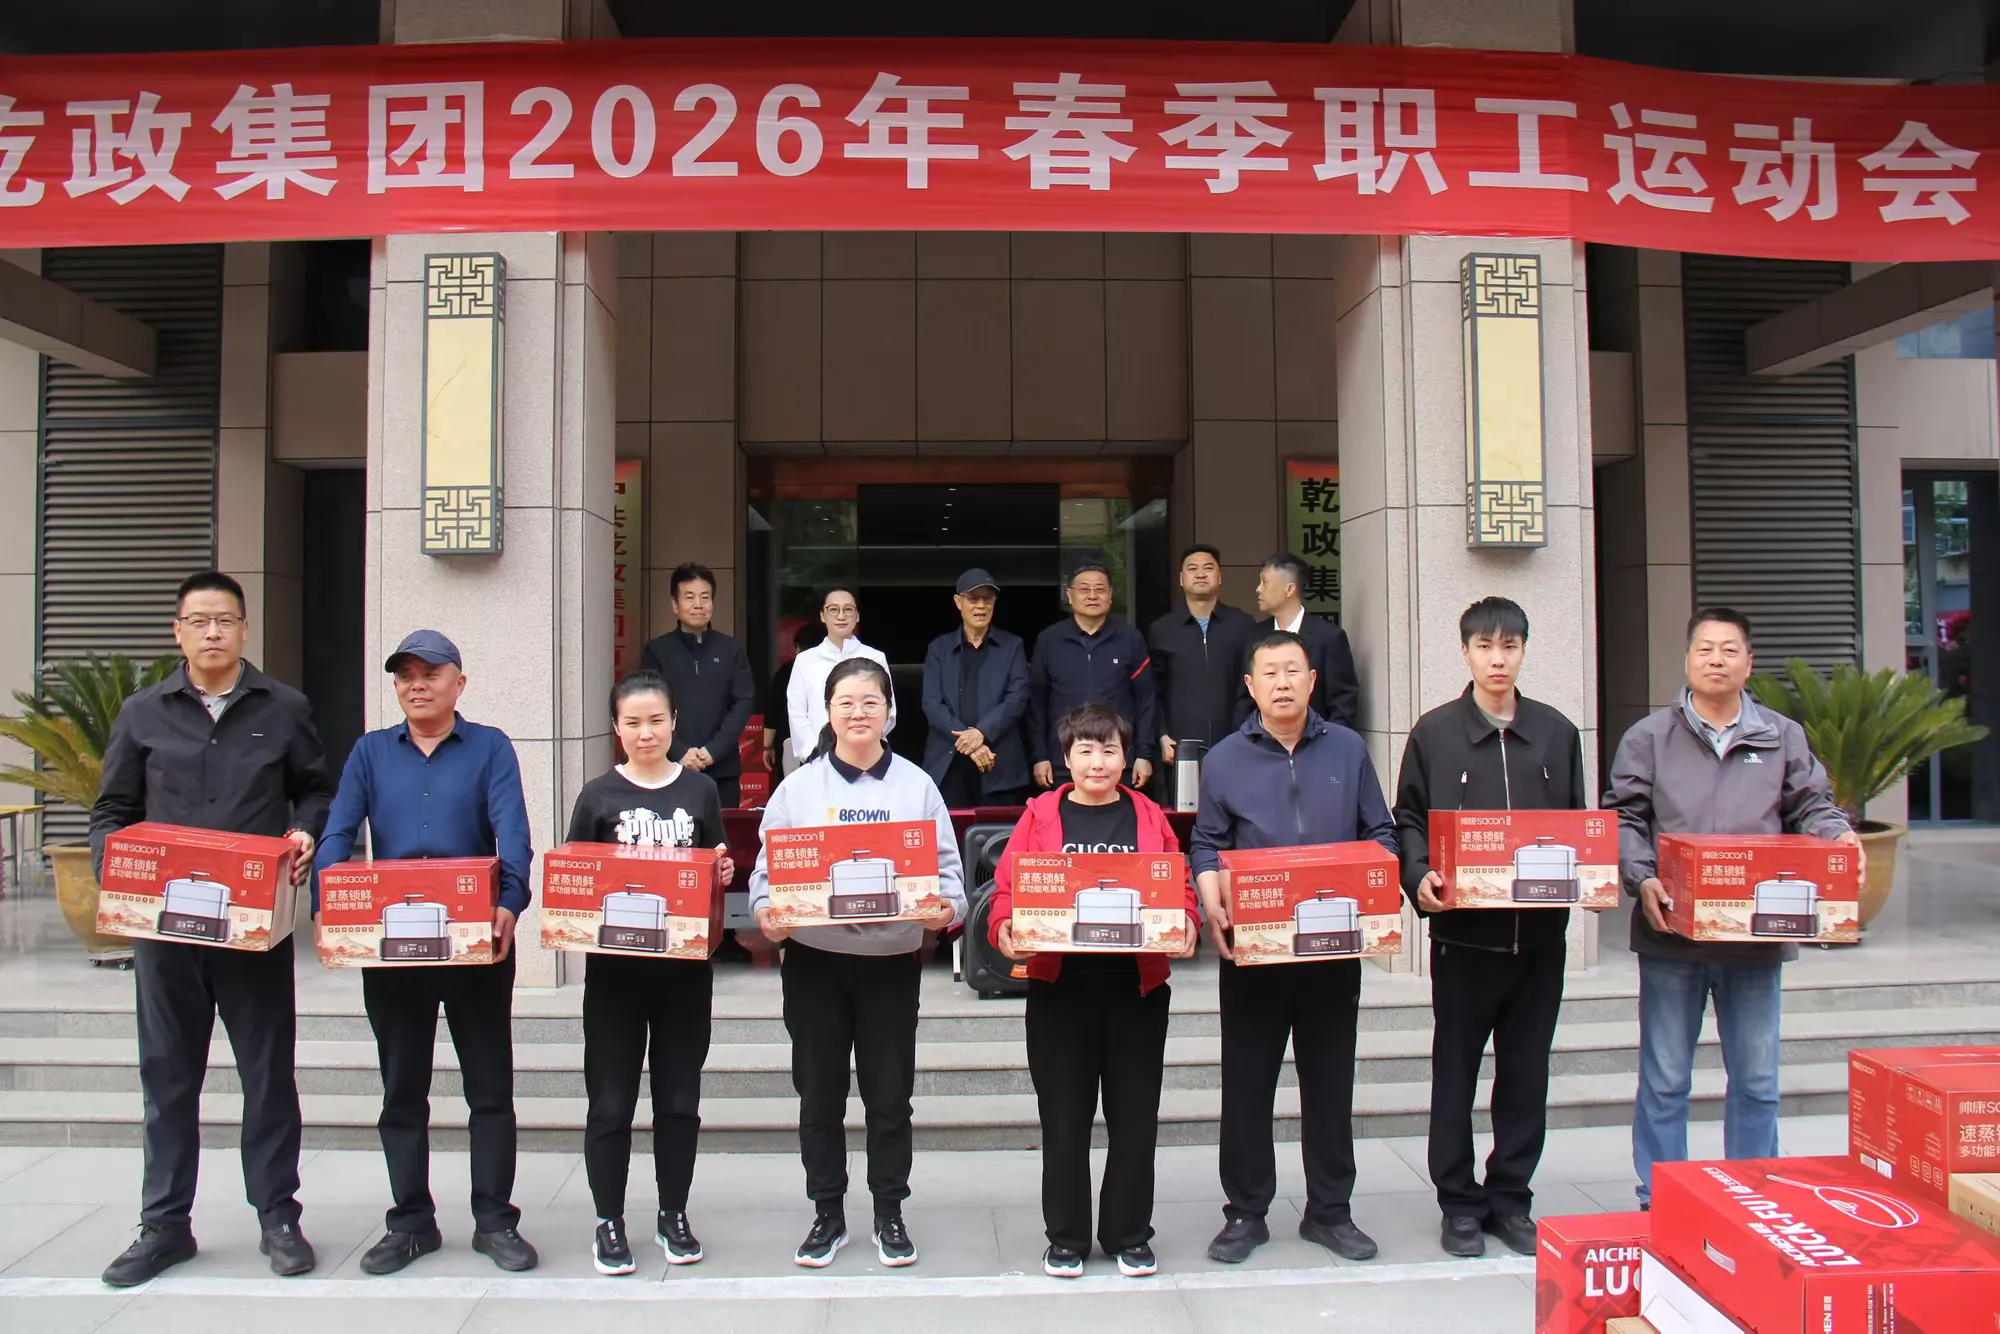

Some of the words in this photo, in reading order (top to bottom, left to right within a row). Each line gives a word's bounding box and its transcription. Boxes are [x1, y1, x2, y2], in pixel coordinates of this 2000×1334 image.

[1300, 478, 1340, 627] 乾政集
[838, 808, 890, 822] BROWN
[1460, 830, 1504, 842] 速蒸锁鲜
[772, 846, 818, 861] 速蒸锁鲜
[109, 855, 157, 871] 速蒸锁鲜
[1701, 865, 1745, 876] 速蒸锁鲜
[549, 873, 594, 886] 速蒸锁鲜
[1019, 872, 1065, 883] 速蒸锁鲜
[325, 888, 371, 901] 速蒸锁鲜
[1238, 886, 1283, 901] 速蒸锁鲜
[1959, 1124, 2000, 1142] 速蒸
[1740, 1200, 1863, 1267] LUCK-FU
[1585, 1265, 1641, 1297] LU
